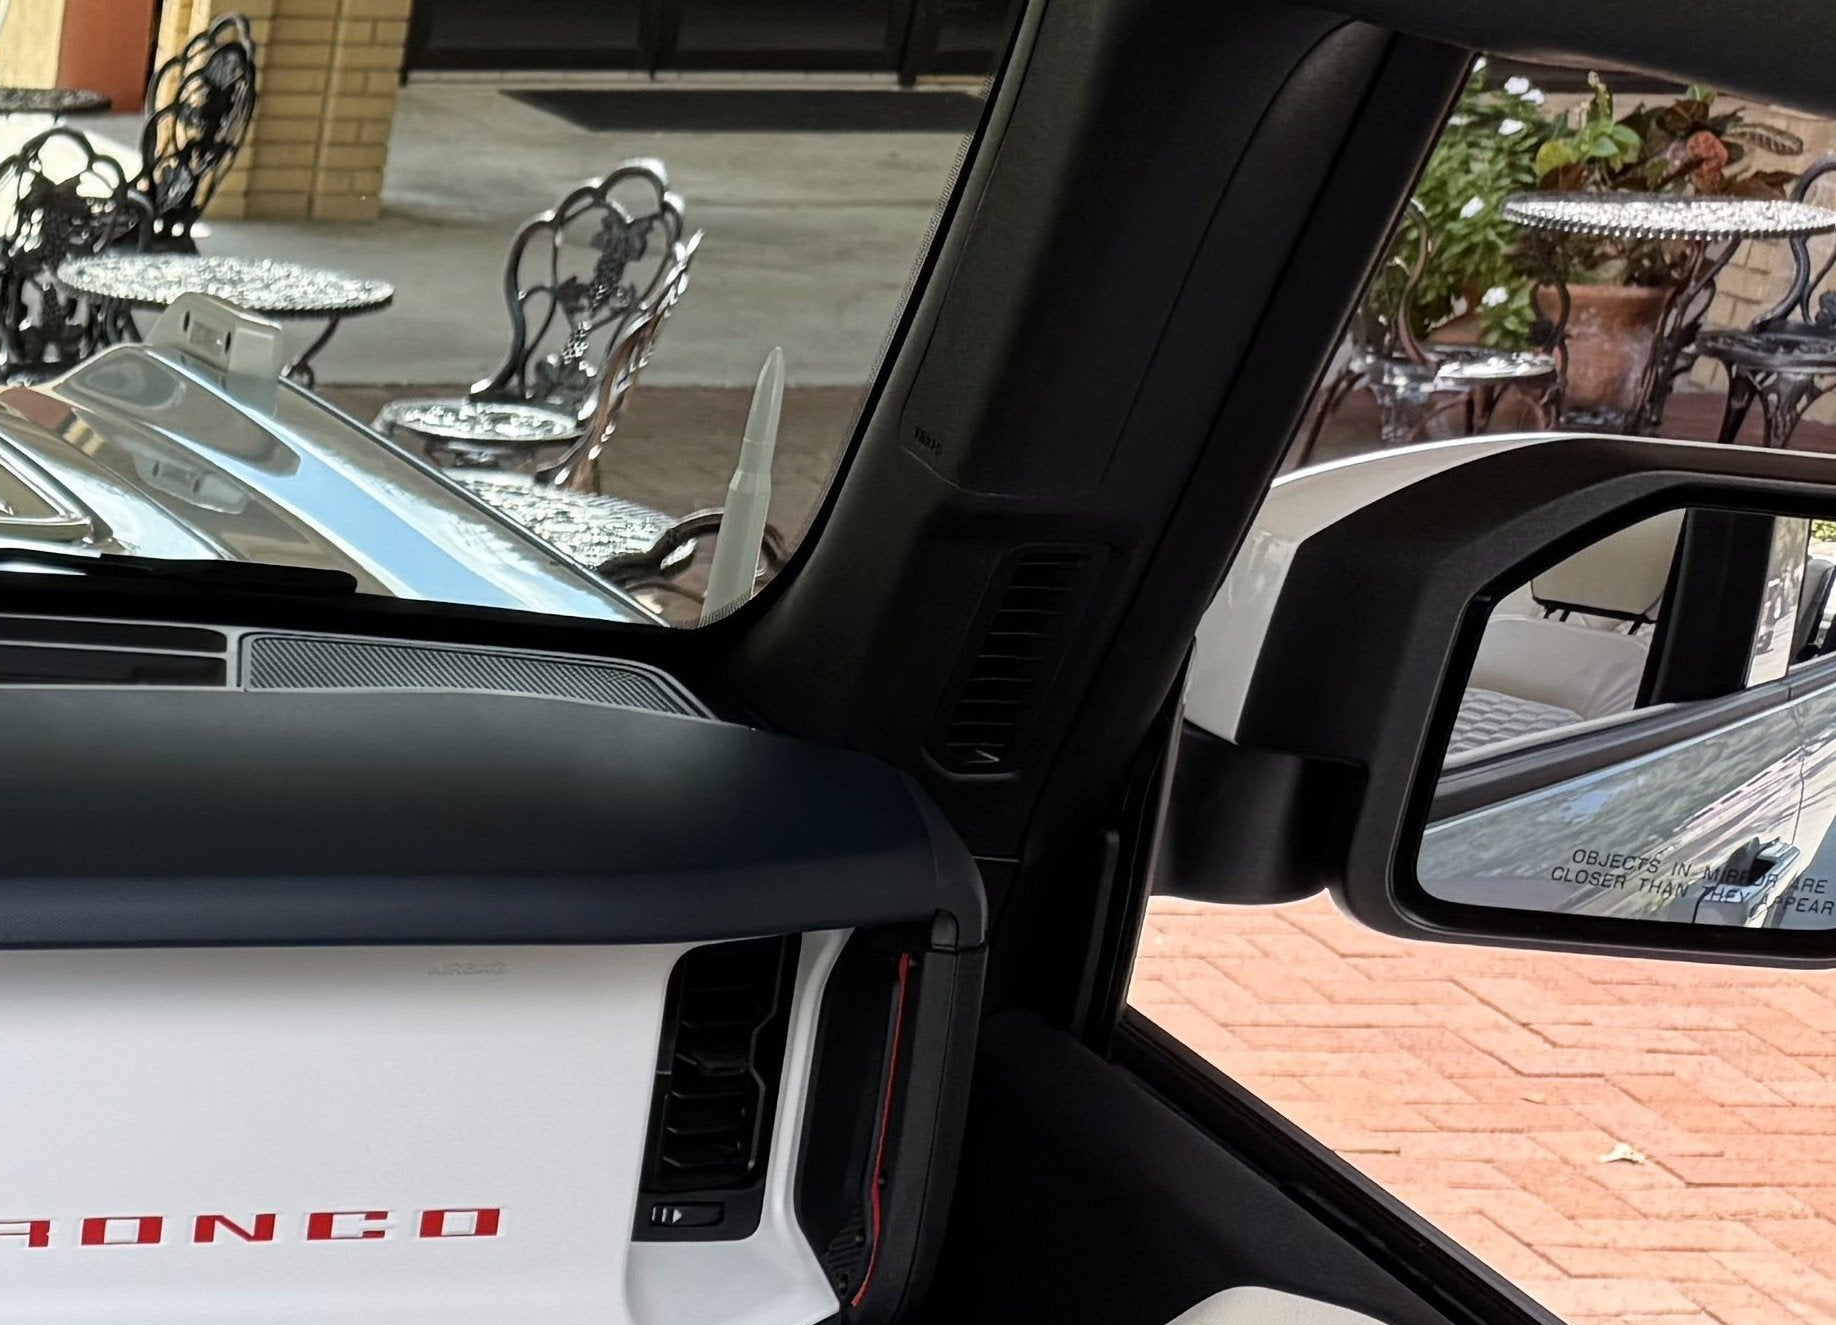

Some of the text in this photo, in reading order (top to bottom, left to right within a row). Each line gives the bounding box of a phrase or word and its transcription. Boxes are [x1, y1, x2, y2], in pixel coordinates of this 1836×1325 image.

[1572, 849, 1661, 874] OBJECTS
[1672, 861, 1691, 877] IN
[1551, 866, 1626, 889] CLOSER
[1639, 878, 1689, 898] THAN
